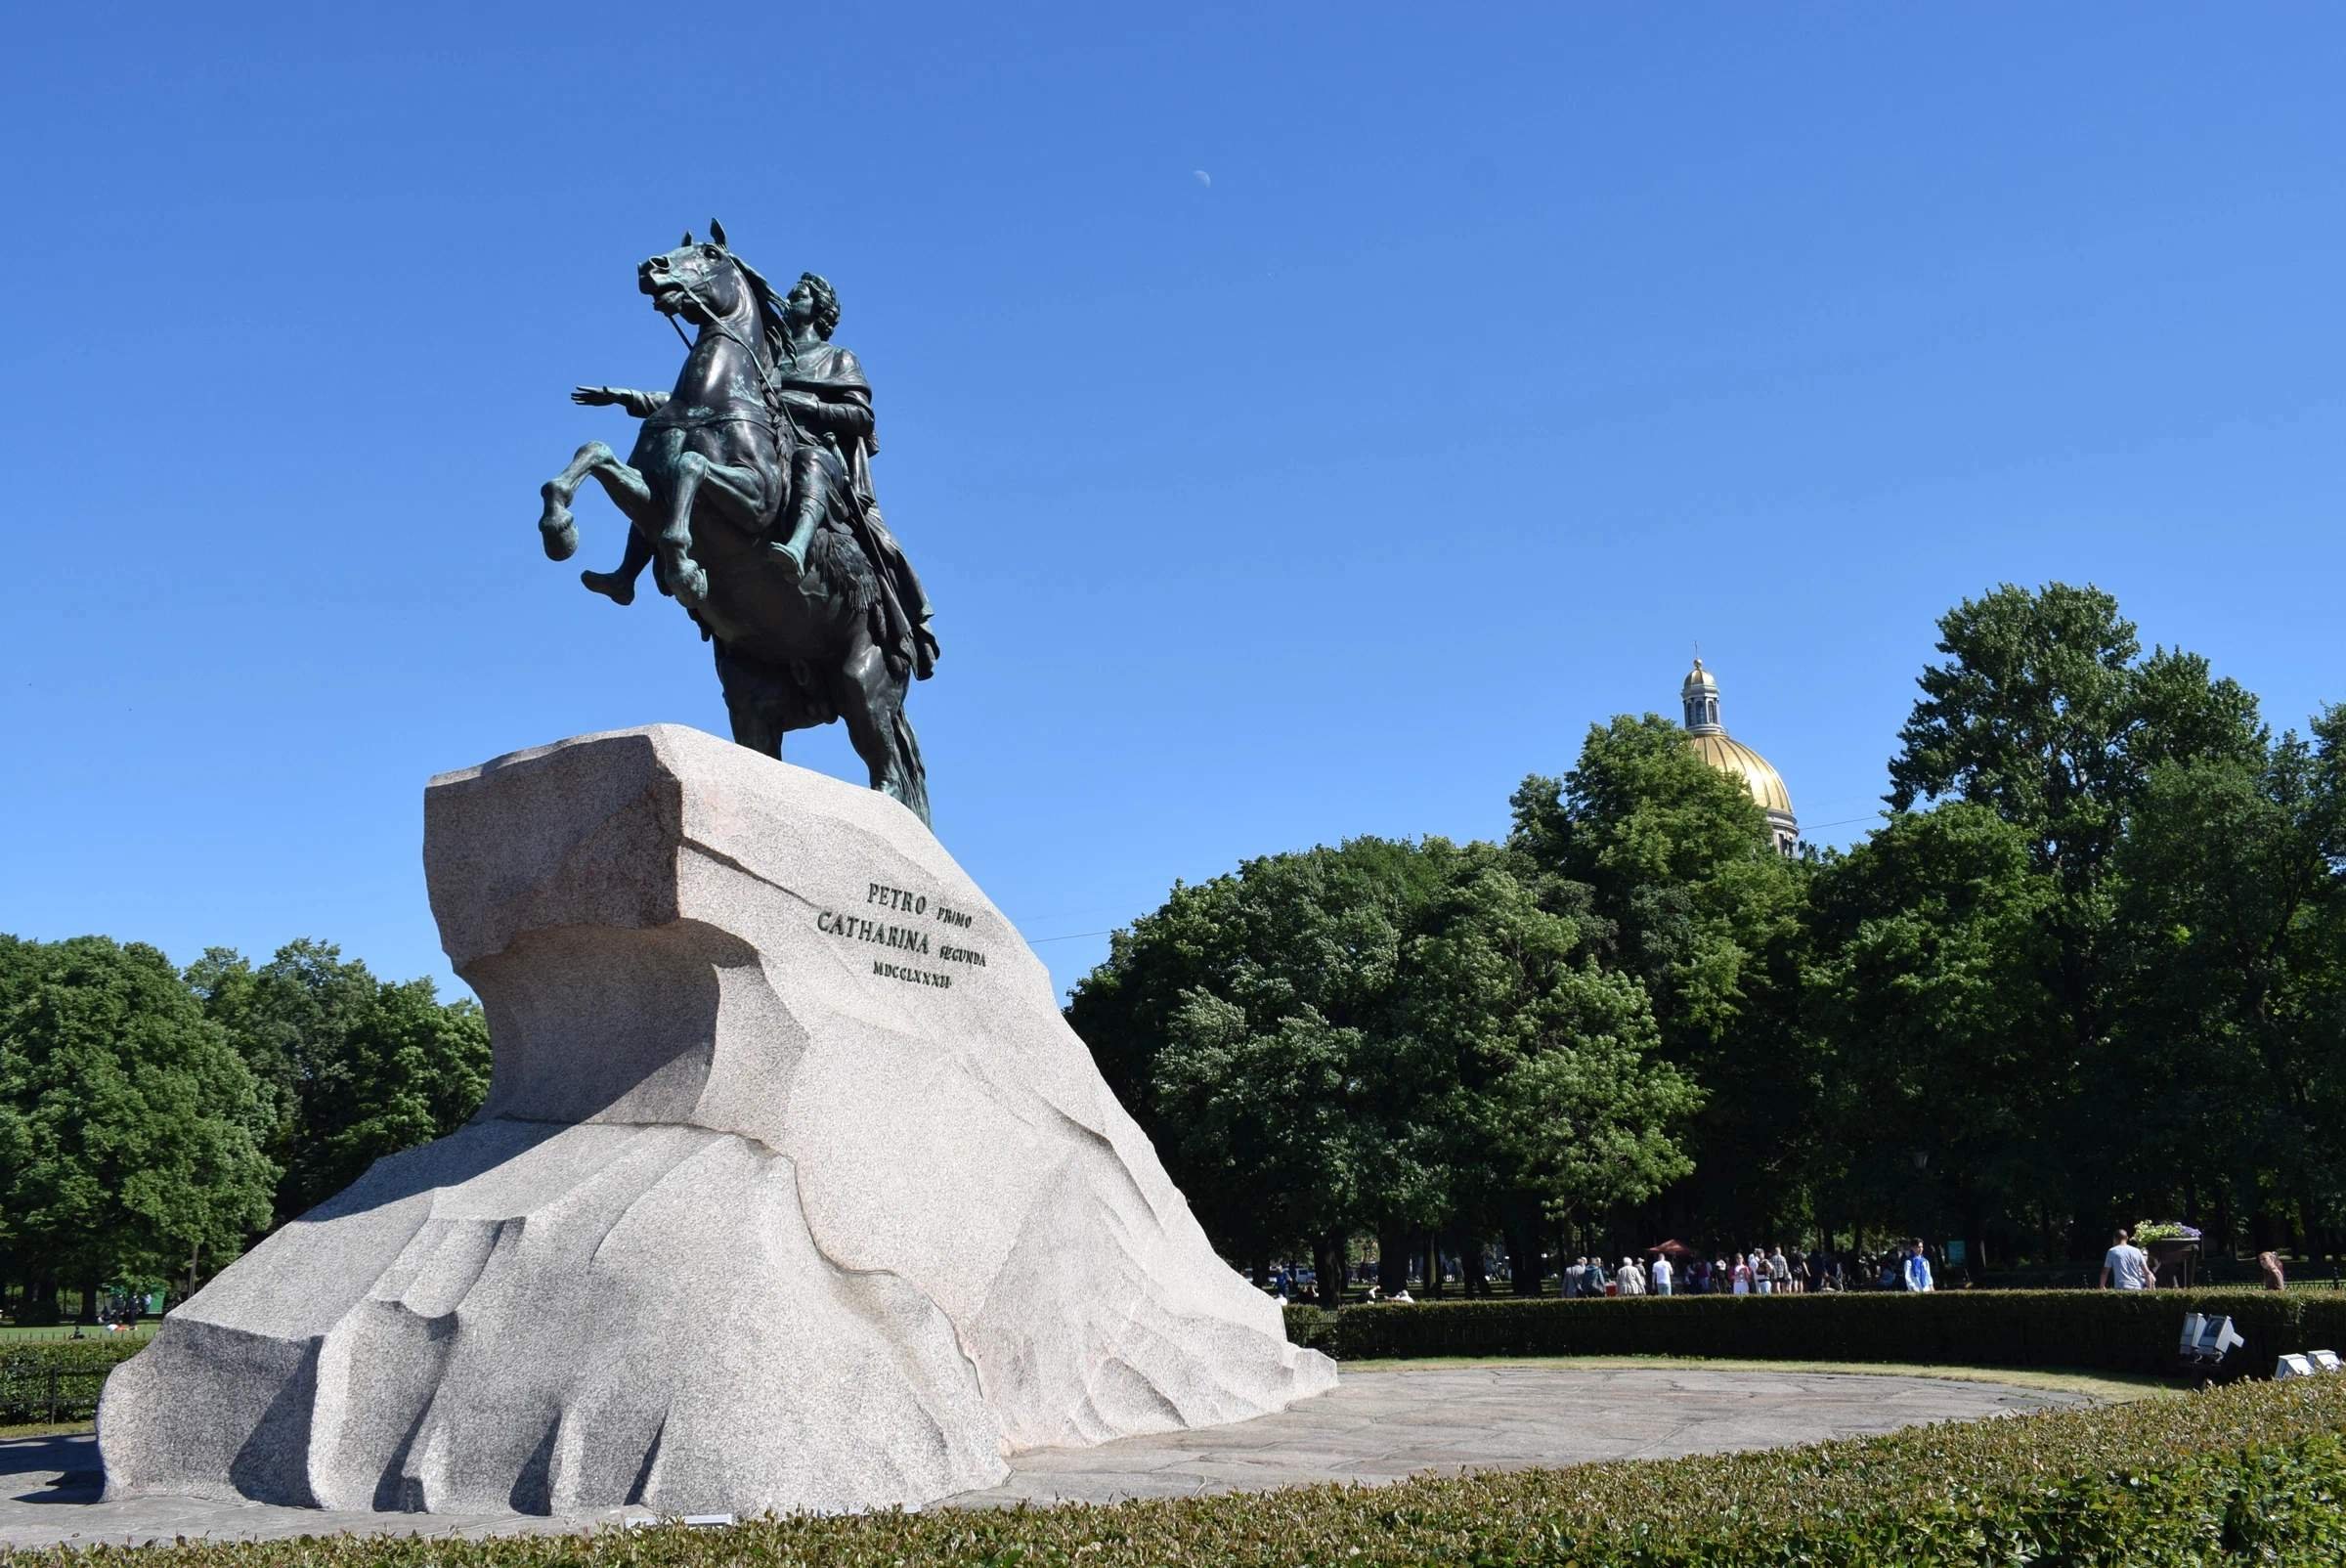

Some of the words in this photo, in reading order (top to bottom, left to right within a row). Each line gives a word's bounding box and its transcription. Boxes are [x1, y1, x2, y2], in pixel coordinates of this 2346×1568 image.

[867, 883, 927, 915] PETRO
[936, 906, 973, 929] PRIMO
[817, 910, 930, 955] CATHARINA
[939, 945, 986, 968] SECUNDA
